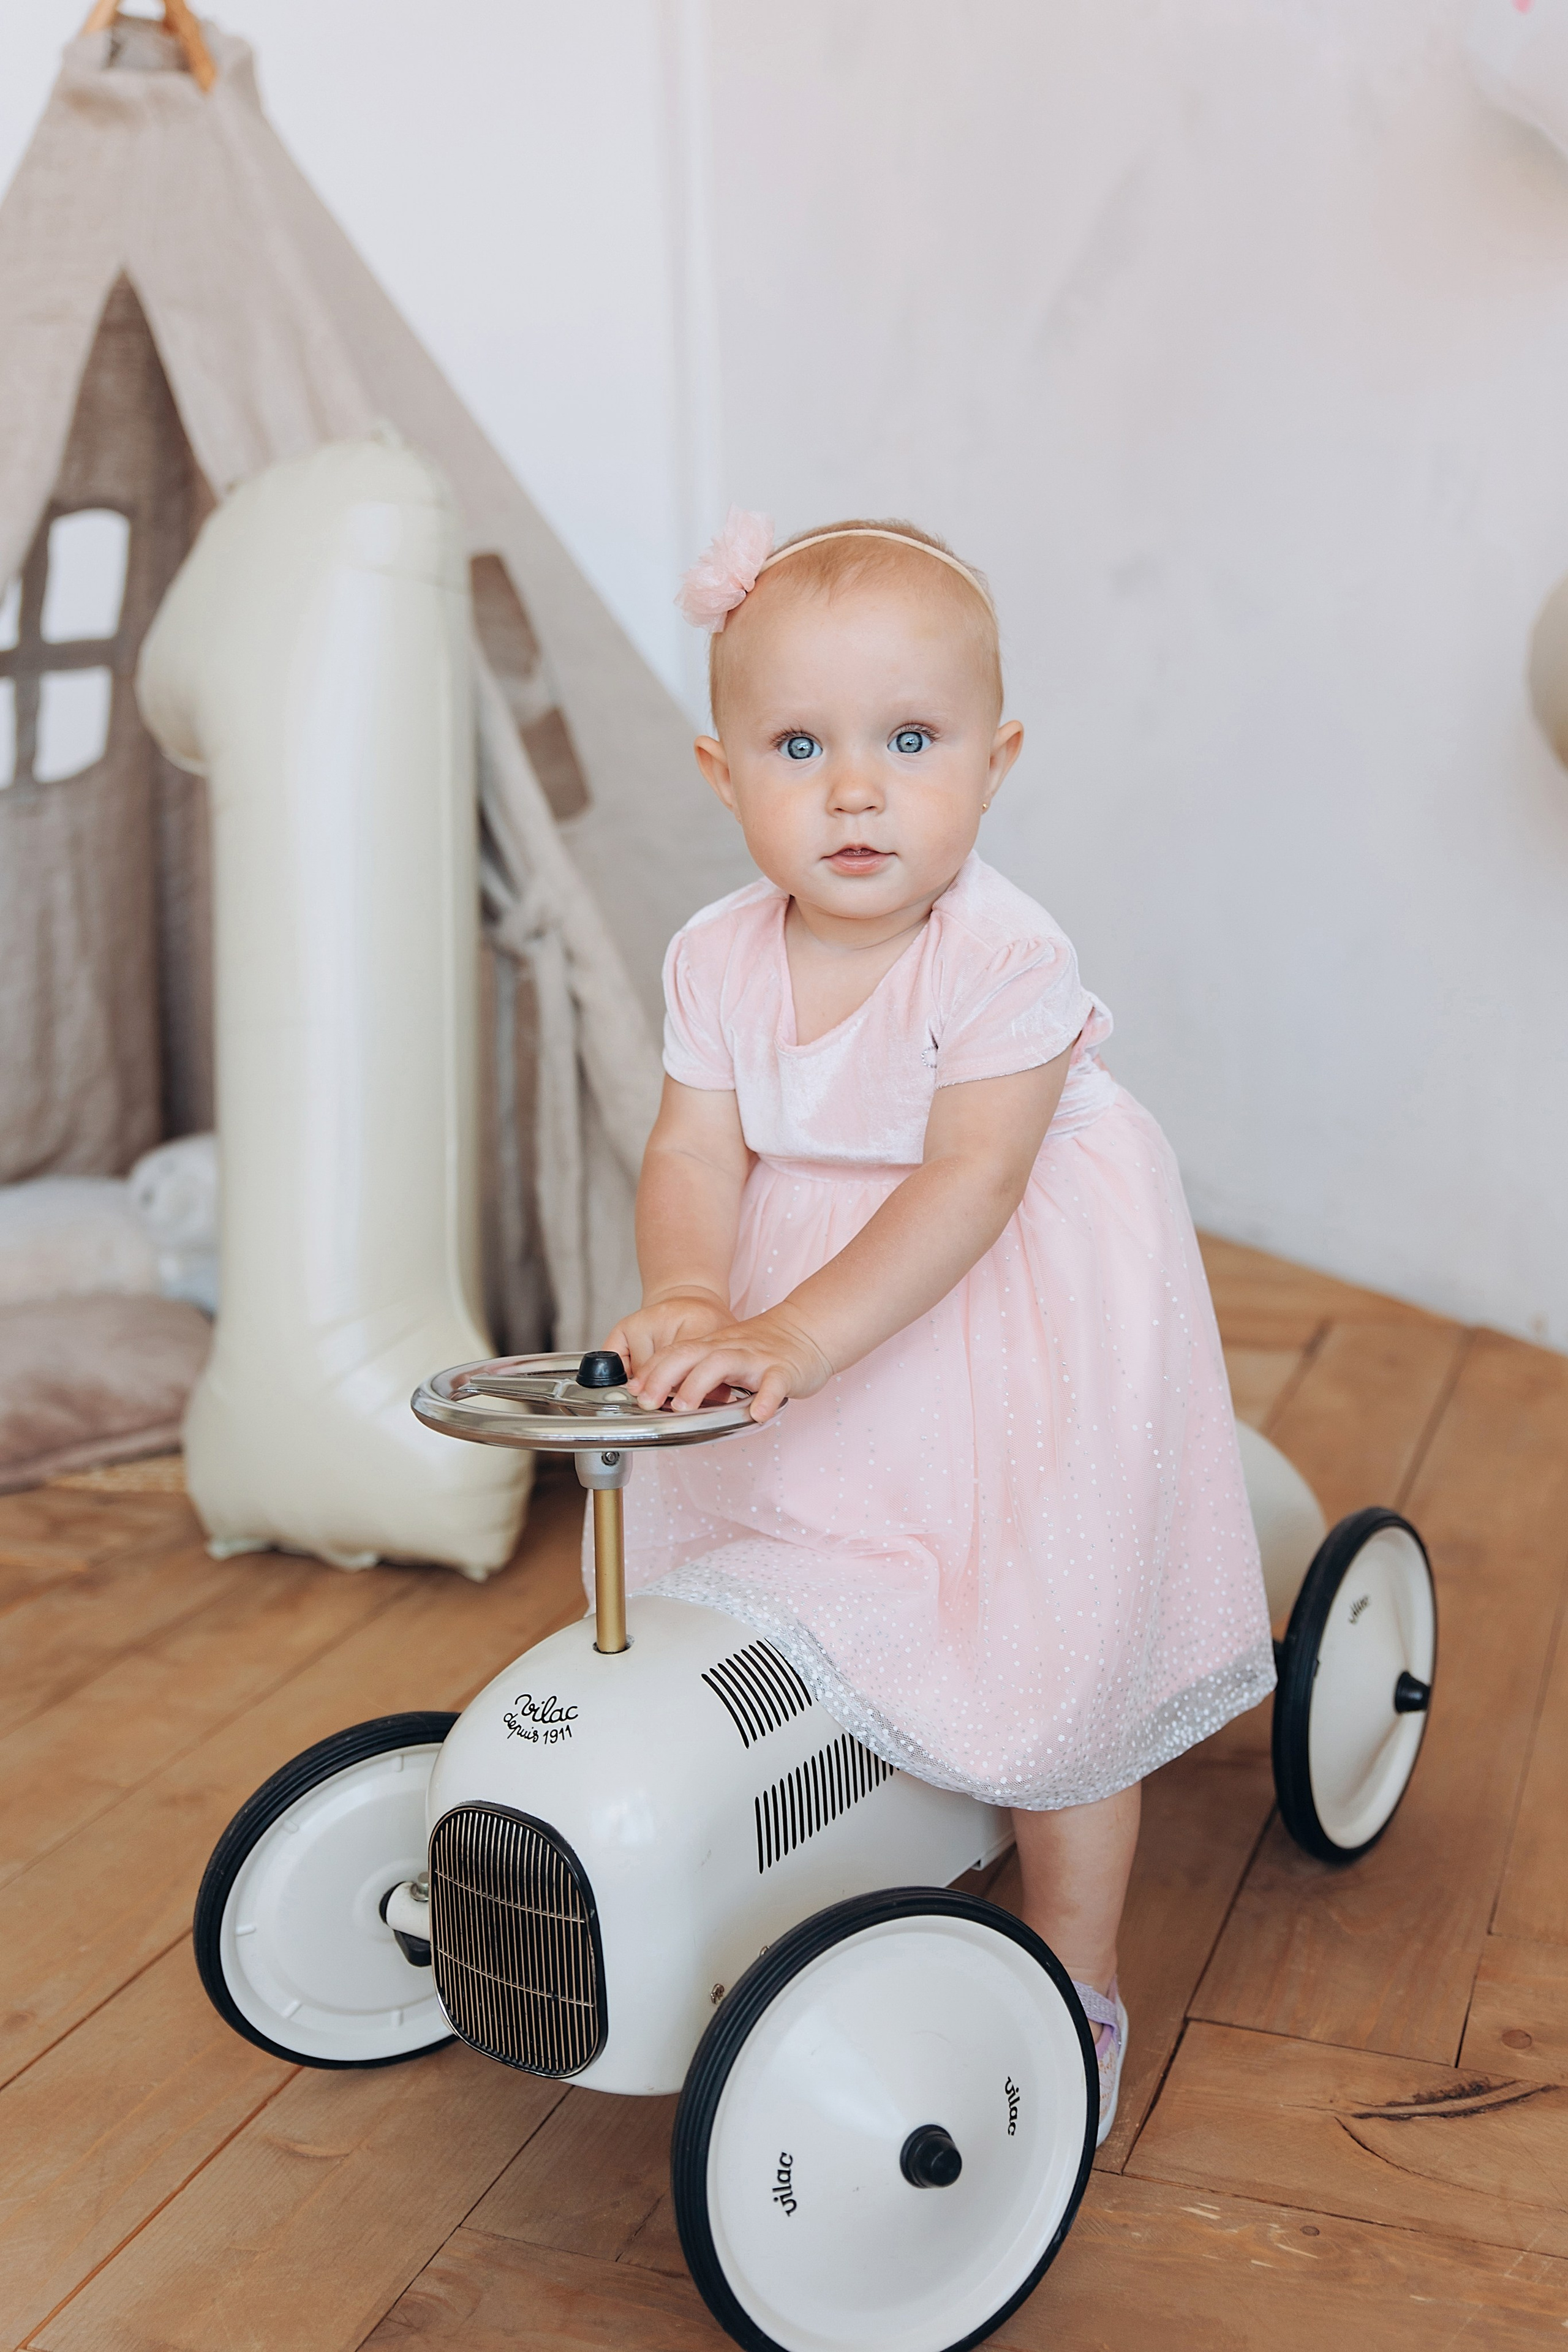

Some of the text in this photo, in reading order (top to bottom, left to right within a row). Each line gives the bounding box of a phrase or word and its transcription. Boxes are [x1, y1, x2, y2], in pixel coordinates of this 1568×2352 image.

[503, 1713, 572, 1744] depuis 1911
[1005, 2076, 1020, 2136] vilac
[772, 2152, 797, 2217] vilac
